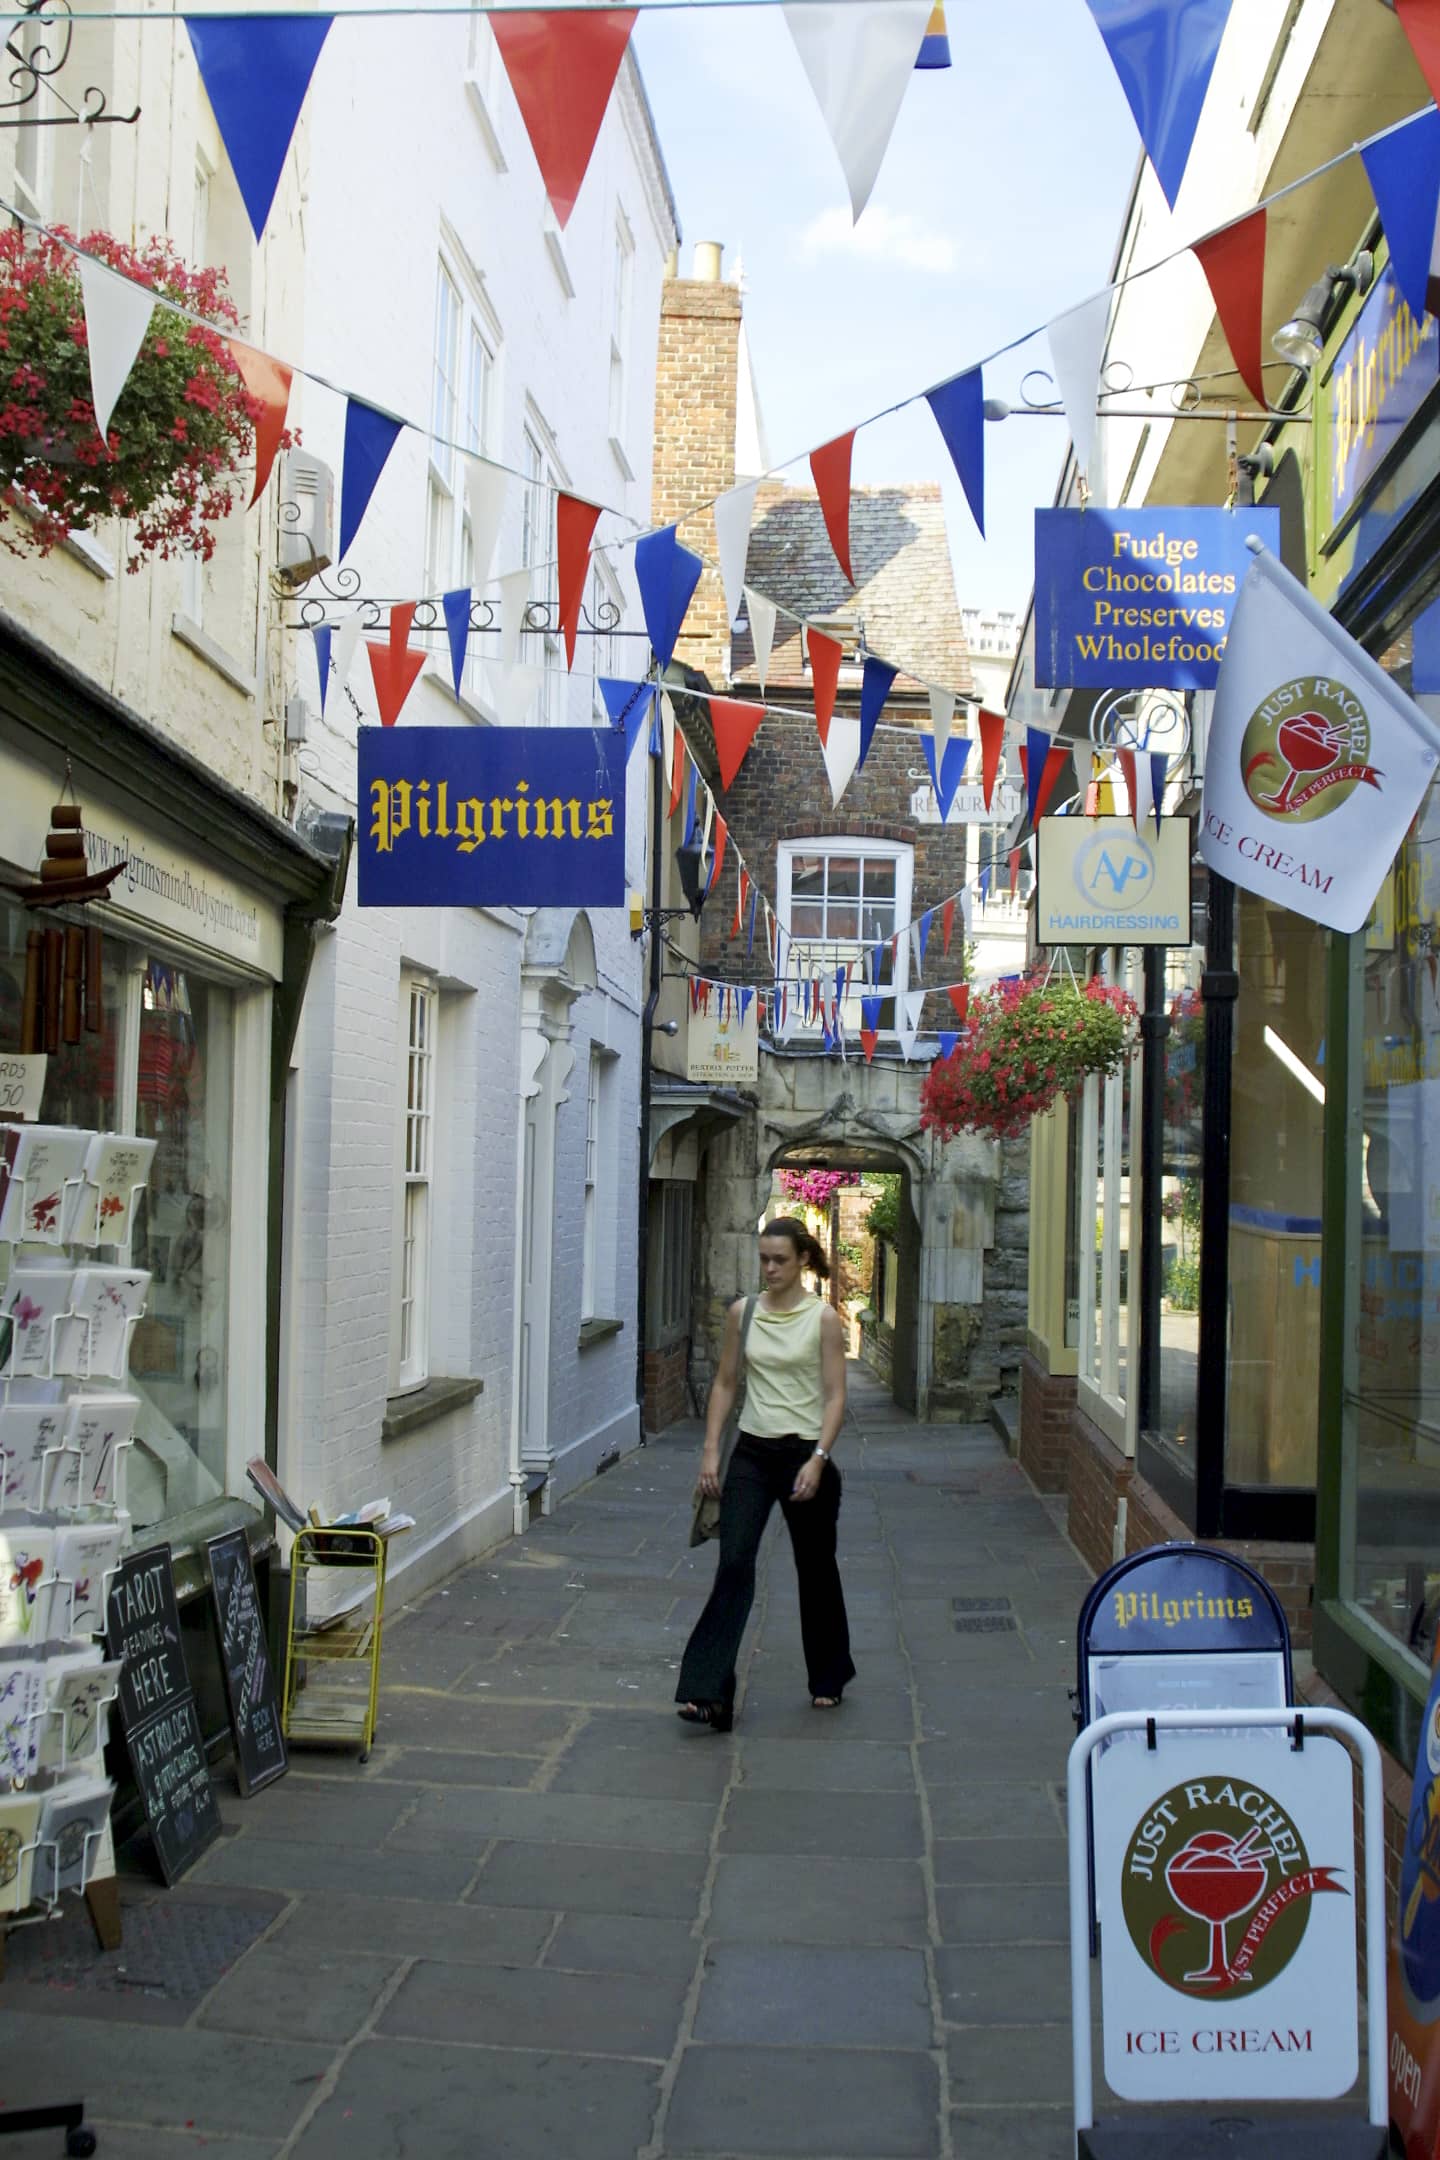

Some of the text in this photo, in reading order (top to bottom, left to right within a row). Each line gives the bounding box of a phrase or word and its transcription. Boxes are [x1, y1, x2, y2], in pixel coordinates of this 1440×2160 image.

[1113, 532, 1198, 567] Fudge
[1083, 566, 1236, 593] Chocolates
[1094, 600, 1225, 628] Preserves
[1260, 679, 1367, 764] JUST RACHEL
[1308, 765, 1368, 795] PERFECT
[370, 779, 614, 853] Pilgrims
[1205, 809, 1334, 894] ICE CREAM
[1049, 913, 1180, 930] HAIRDRESSING
[726, 1064, 755, 1072] POTTER
[111, 1564, 165, 1628] TAROT
[1114, 1591, 1253, 1629] Pilgrims
[130, 1653, 174, 1712] HERE
[138, 1696, 192, 1769] ASTROLOGY
[1130, 1783, 1302, 1881] JUST RACHEL
[1227, 1871, 1320, 1985] JUST PERFECT
[1126, 2029, 1313, 2055] ICE CREAM
[1391, 2030, 1422, 2109] open
